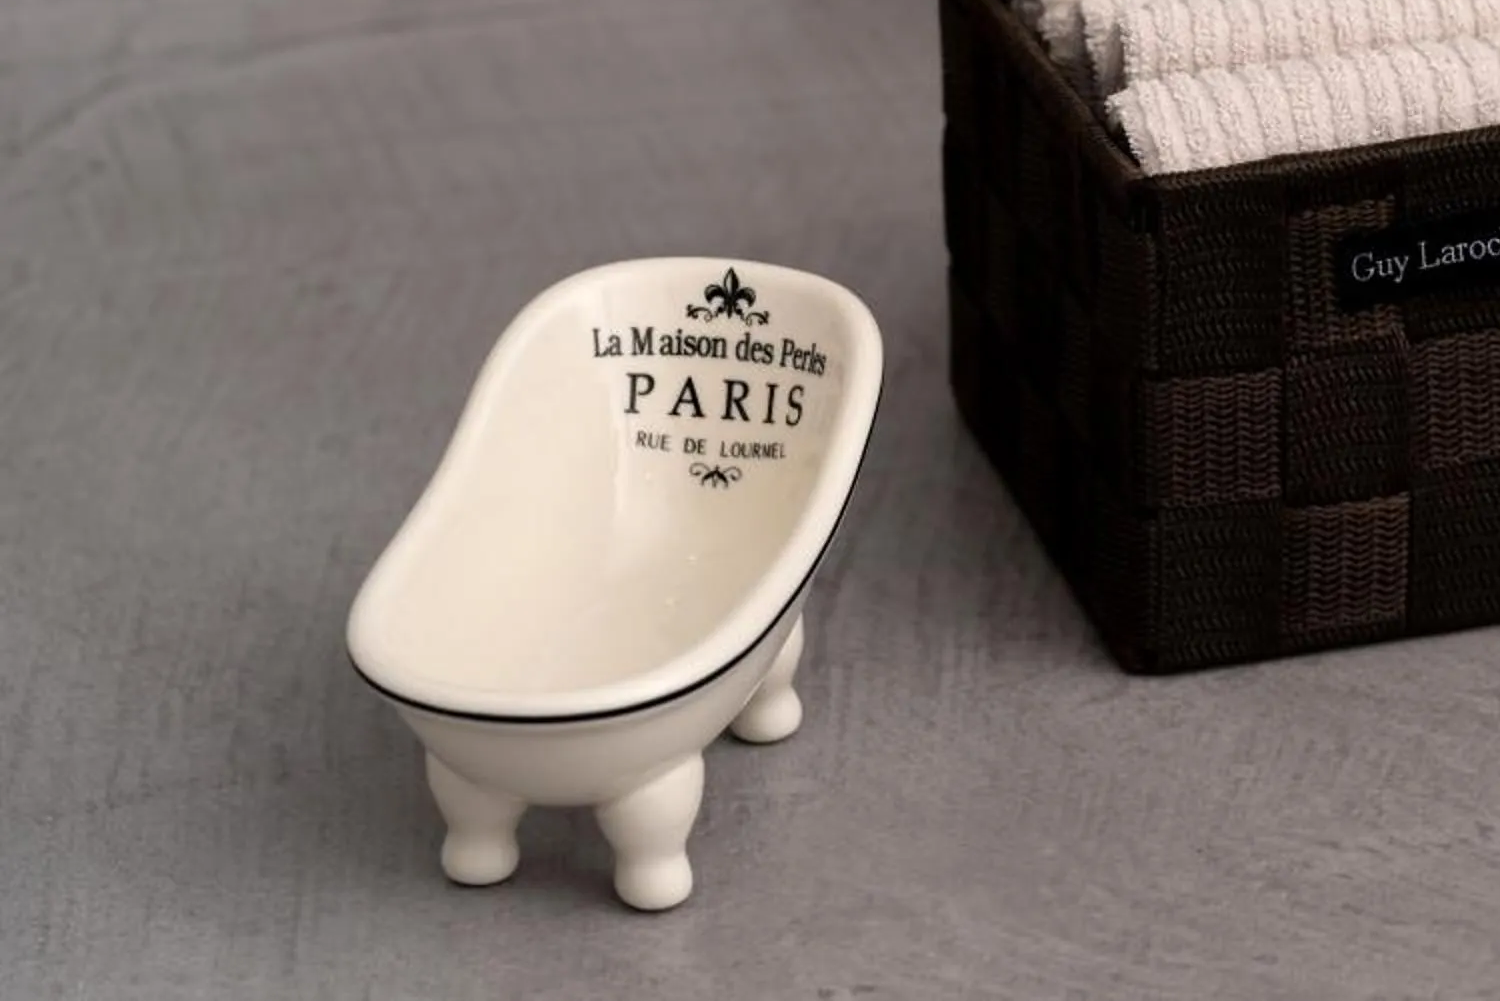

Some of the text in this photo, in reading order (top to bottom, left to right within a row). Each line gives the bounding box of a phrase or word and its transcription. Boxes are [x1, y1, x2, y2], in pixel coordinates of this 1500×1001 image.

[1351, 251, 1409, 284] Guy
[592, 328, 623, 358] La
[631, 326, 727, 360] Maison
[735, 332, 774, 365] des
[624, 372, 805, 427] PARIS
[635, 431, 670, 452] RUE
[683, 437, 707, 456] DE
